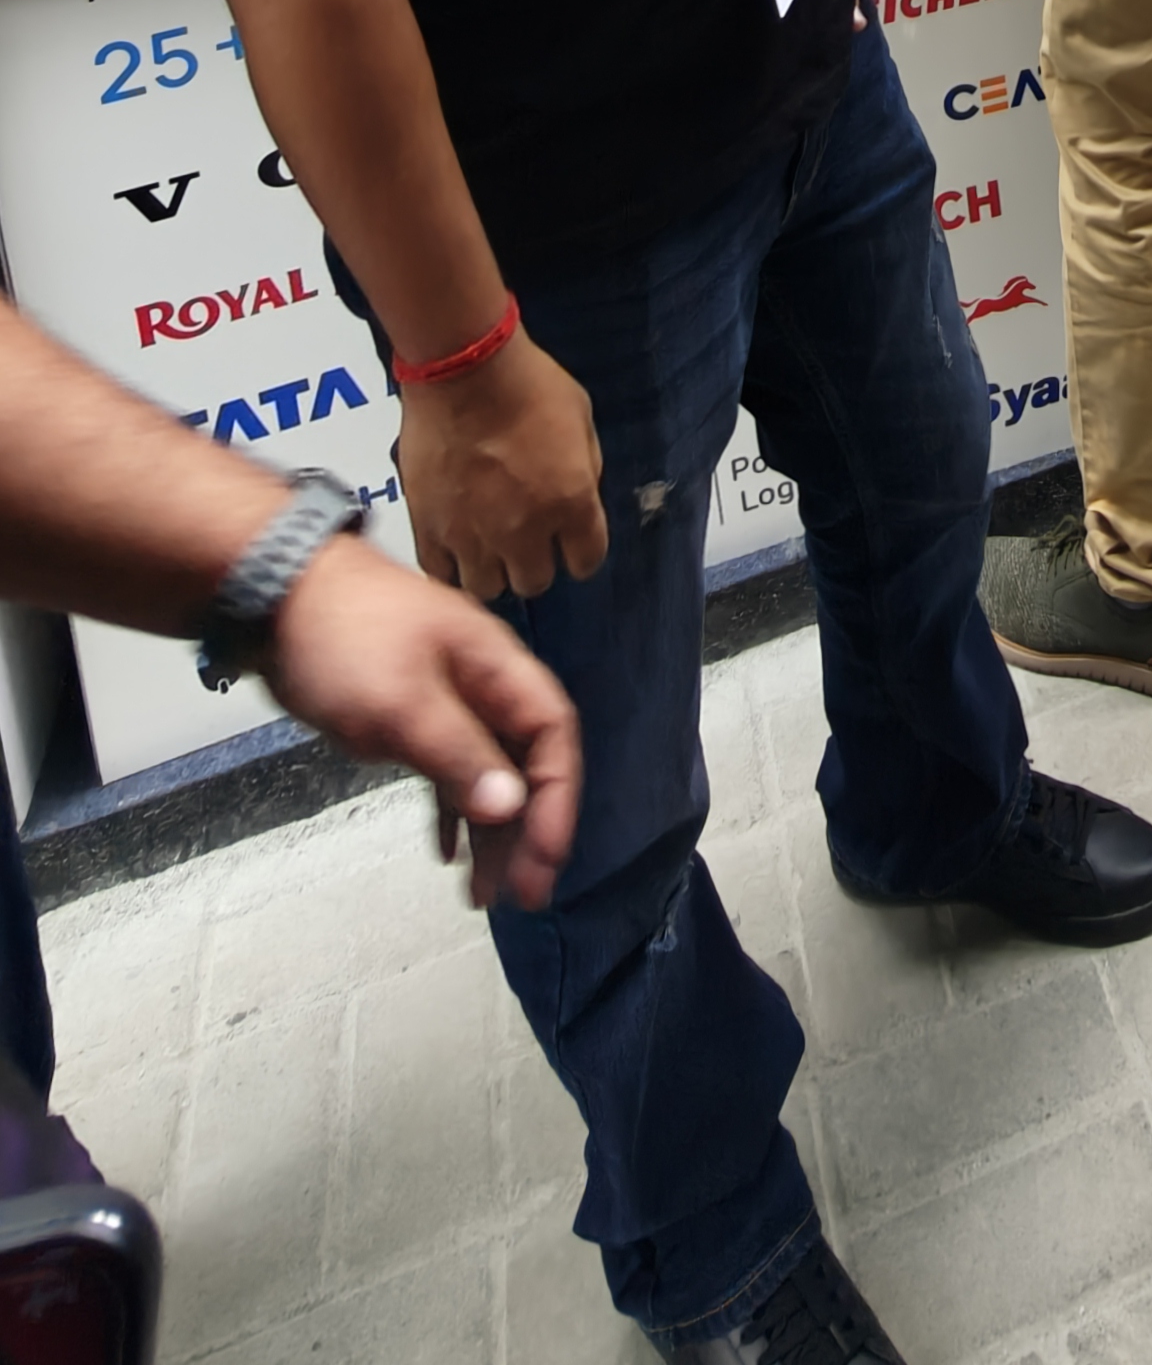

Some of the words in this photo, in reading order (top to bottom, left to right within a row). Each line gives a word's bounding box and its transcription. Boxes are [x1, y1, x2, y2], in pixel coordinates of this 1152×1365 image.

[943, 68, 1047, 121] CEA
[933, 178, 1002, 231] CH
[133, 267, 319, 349] ROYAL
[740, 480, 795, 513] Log
